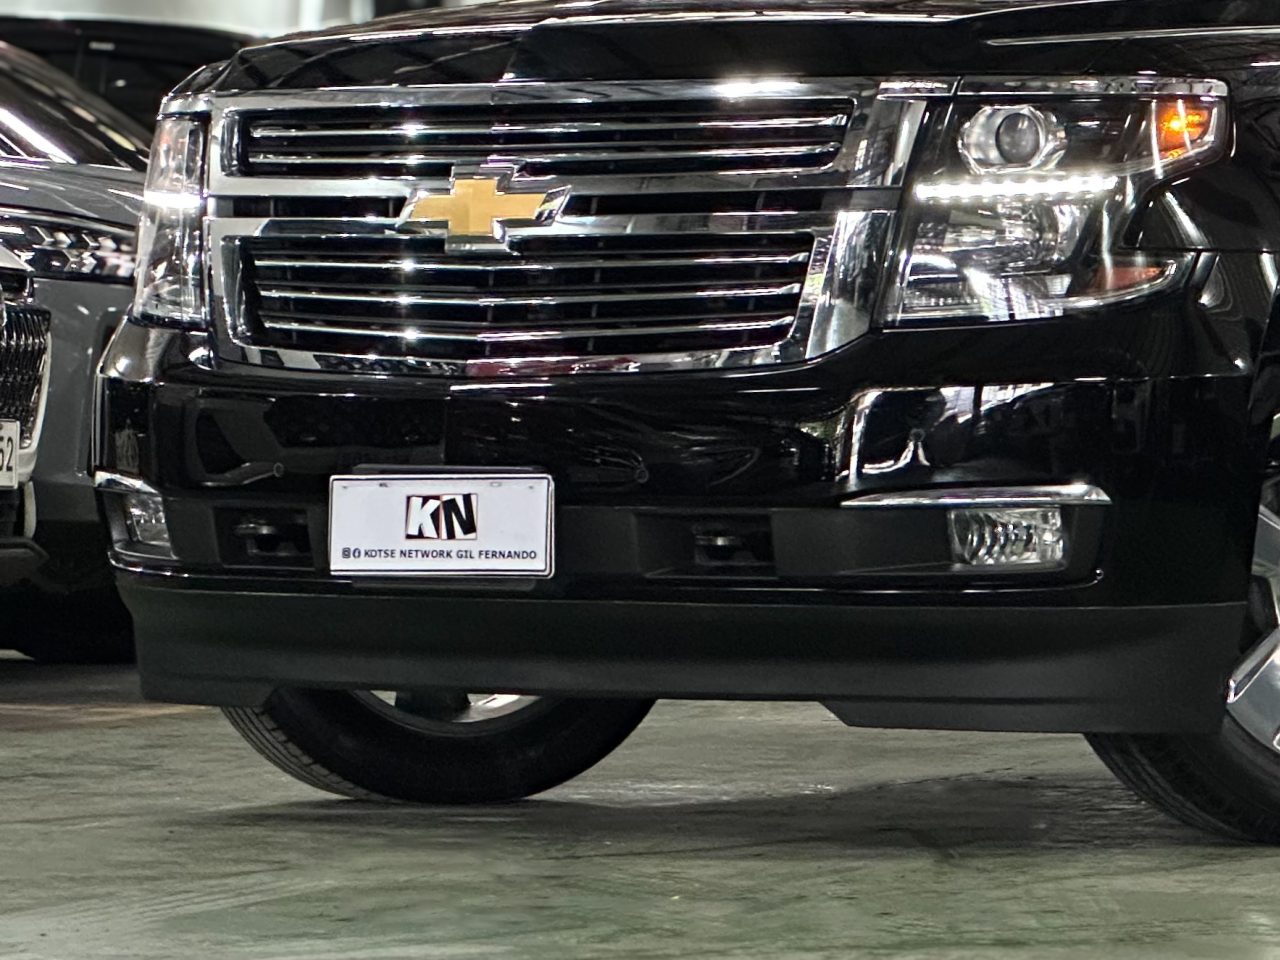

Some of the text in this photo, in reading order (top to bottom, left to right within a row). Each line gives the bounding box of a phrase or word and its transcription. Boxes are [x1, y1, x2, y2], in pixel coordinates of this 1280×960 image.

[406, 494, 477, 539] KN
[363, 548, 537, 559] KOTSE NETWORK GIL FERNANDO
